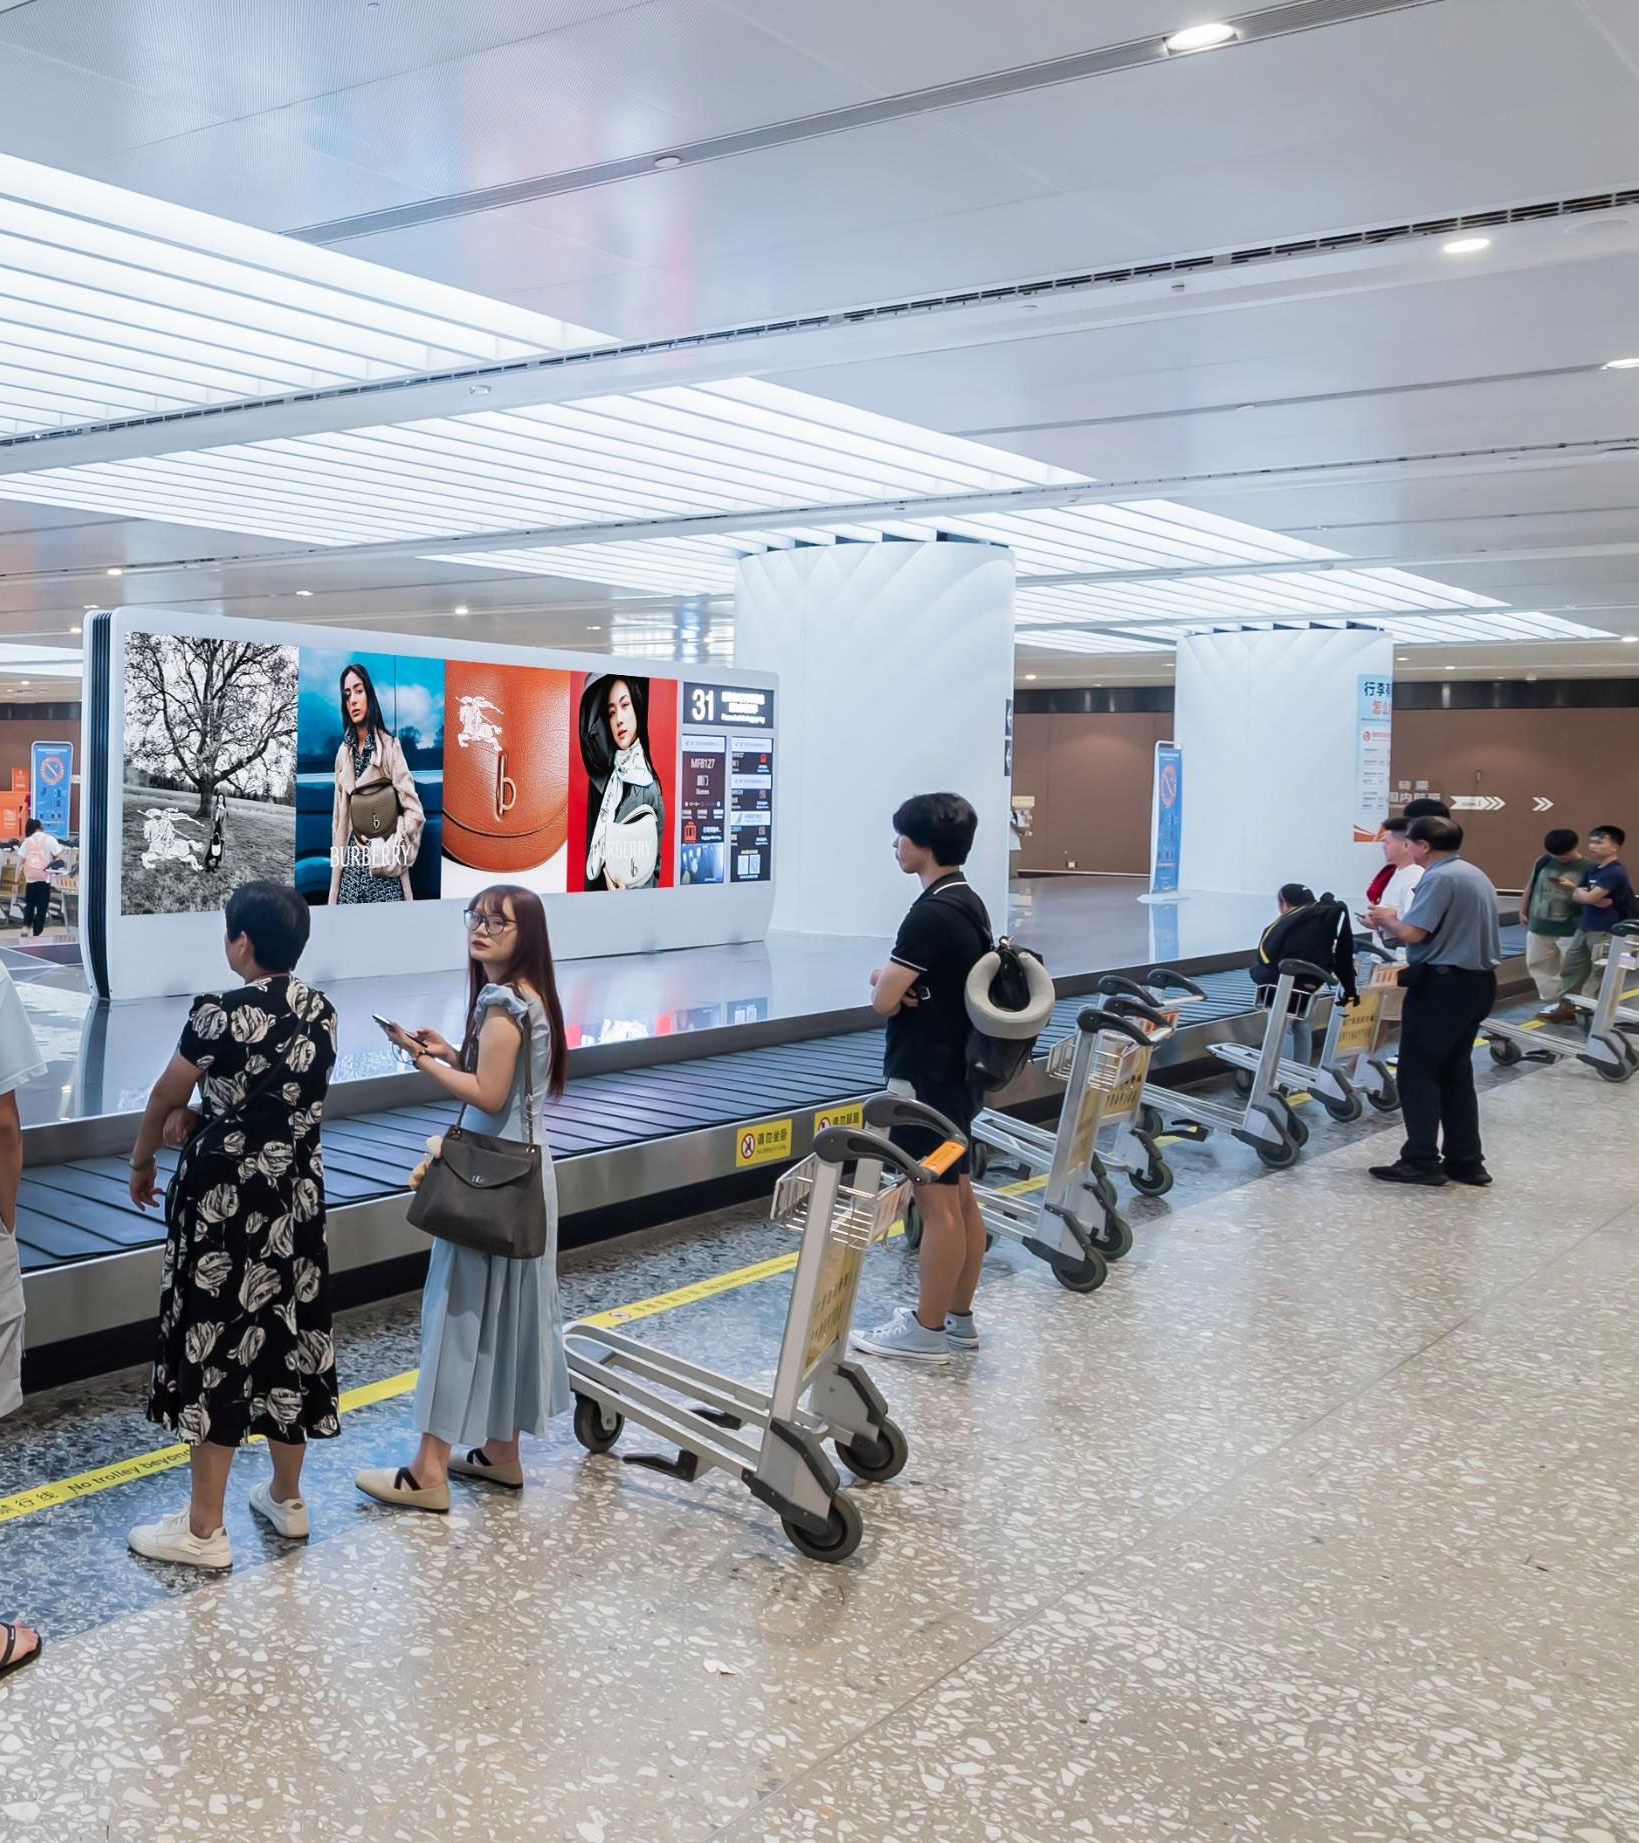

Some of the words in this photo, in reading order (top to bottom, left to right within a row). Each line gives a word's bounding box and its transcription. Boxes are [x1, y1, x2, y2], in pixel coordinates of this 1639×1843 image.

[692, 689, 714, 721] 31
[330, 845, 411, 867] BURBERRY
[67, 1481, 92, 1495] No
[92, 1466, 141, 1484] trolley
